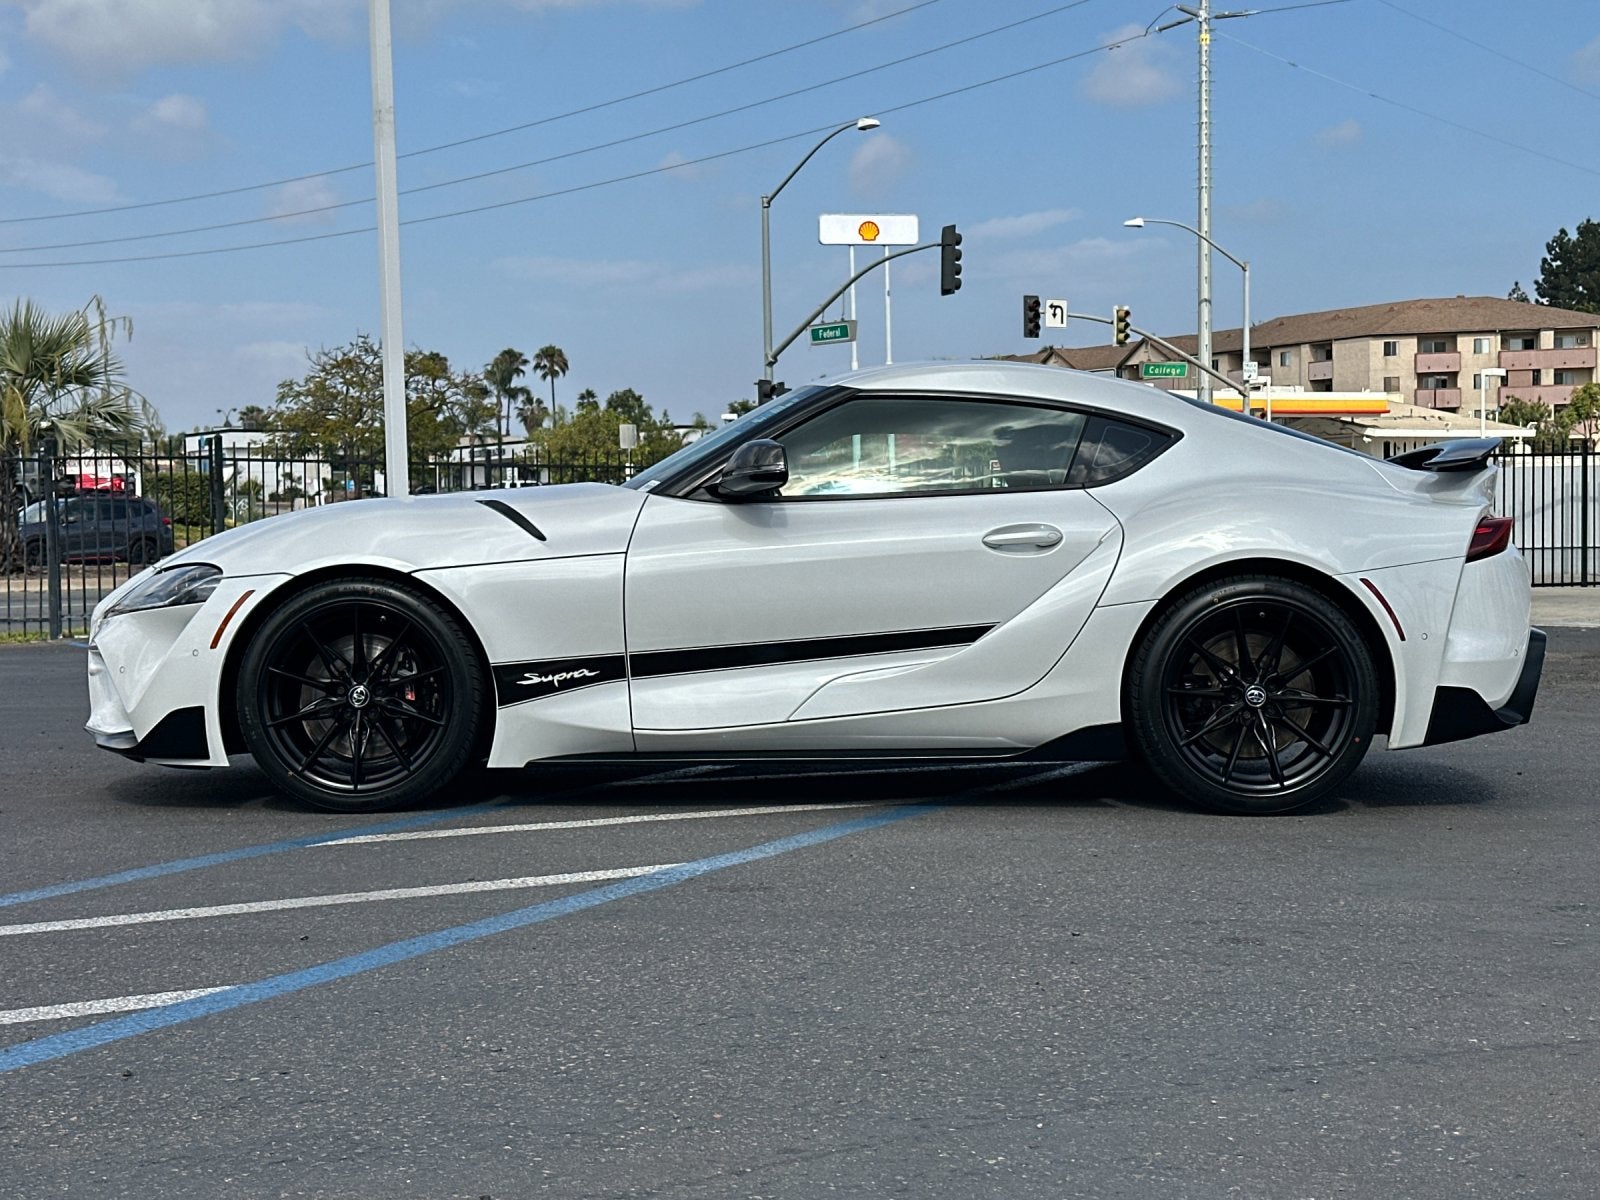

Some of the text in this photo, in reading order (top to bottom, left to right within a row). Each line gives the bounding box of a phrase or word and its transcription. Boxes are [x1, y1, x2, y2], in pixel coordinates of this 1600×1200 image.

[818, 327, 841, 339] Federal
[1148, 366, 1181, 376] College
[516, 668, 600, 688] Supra
